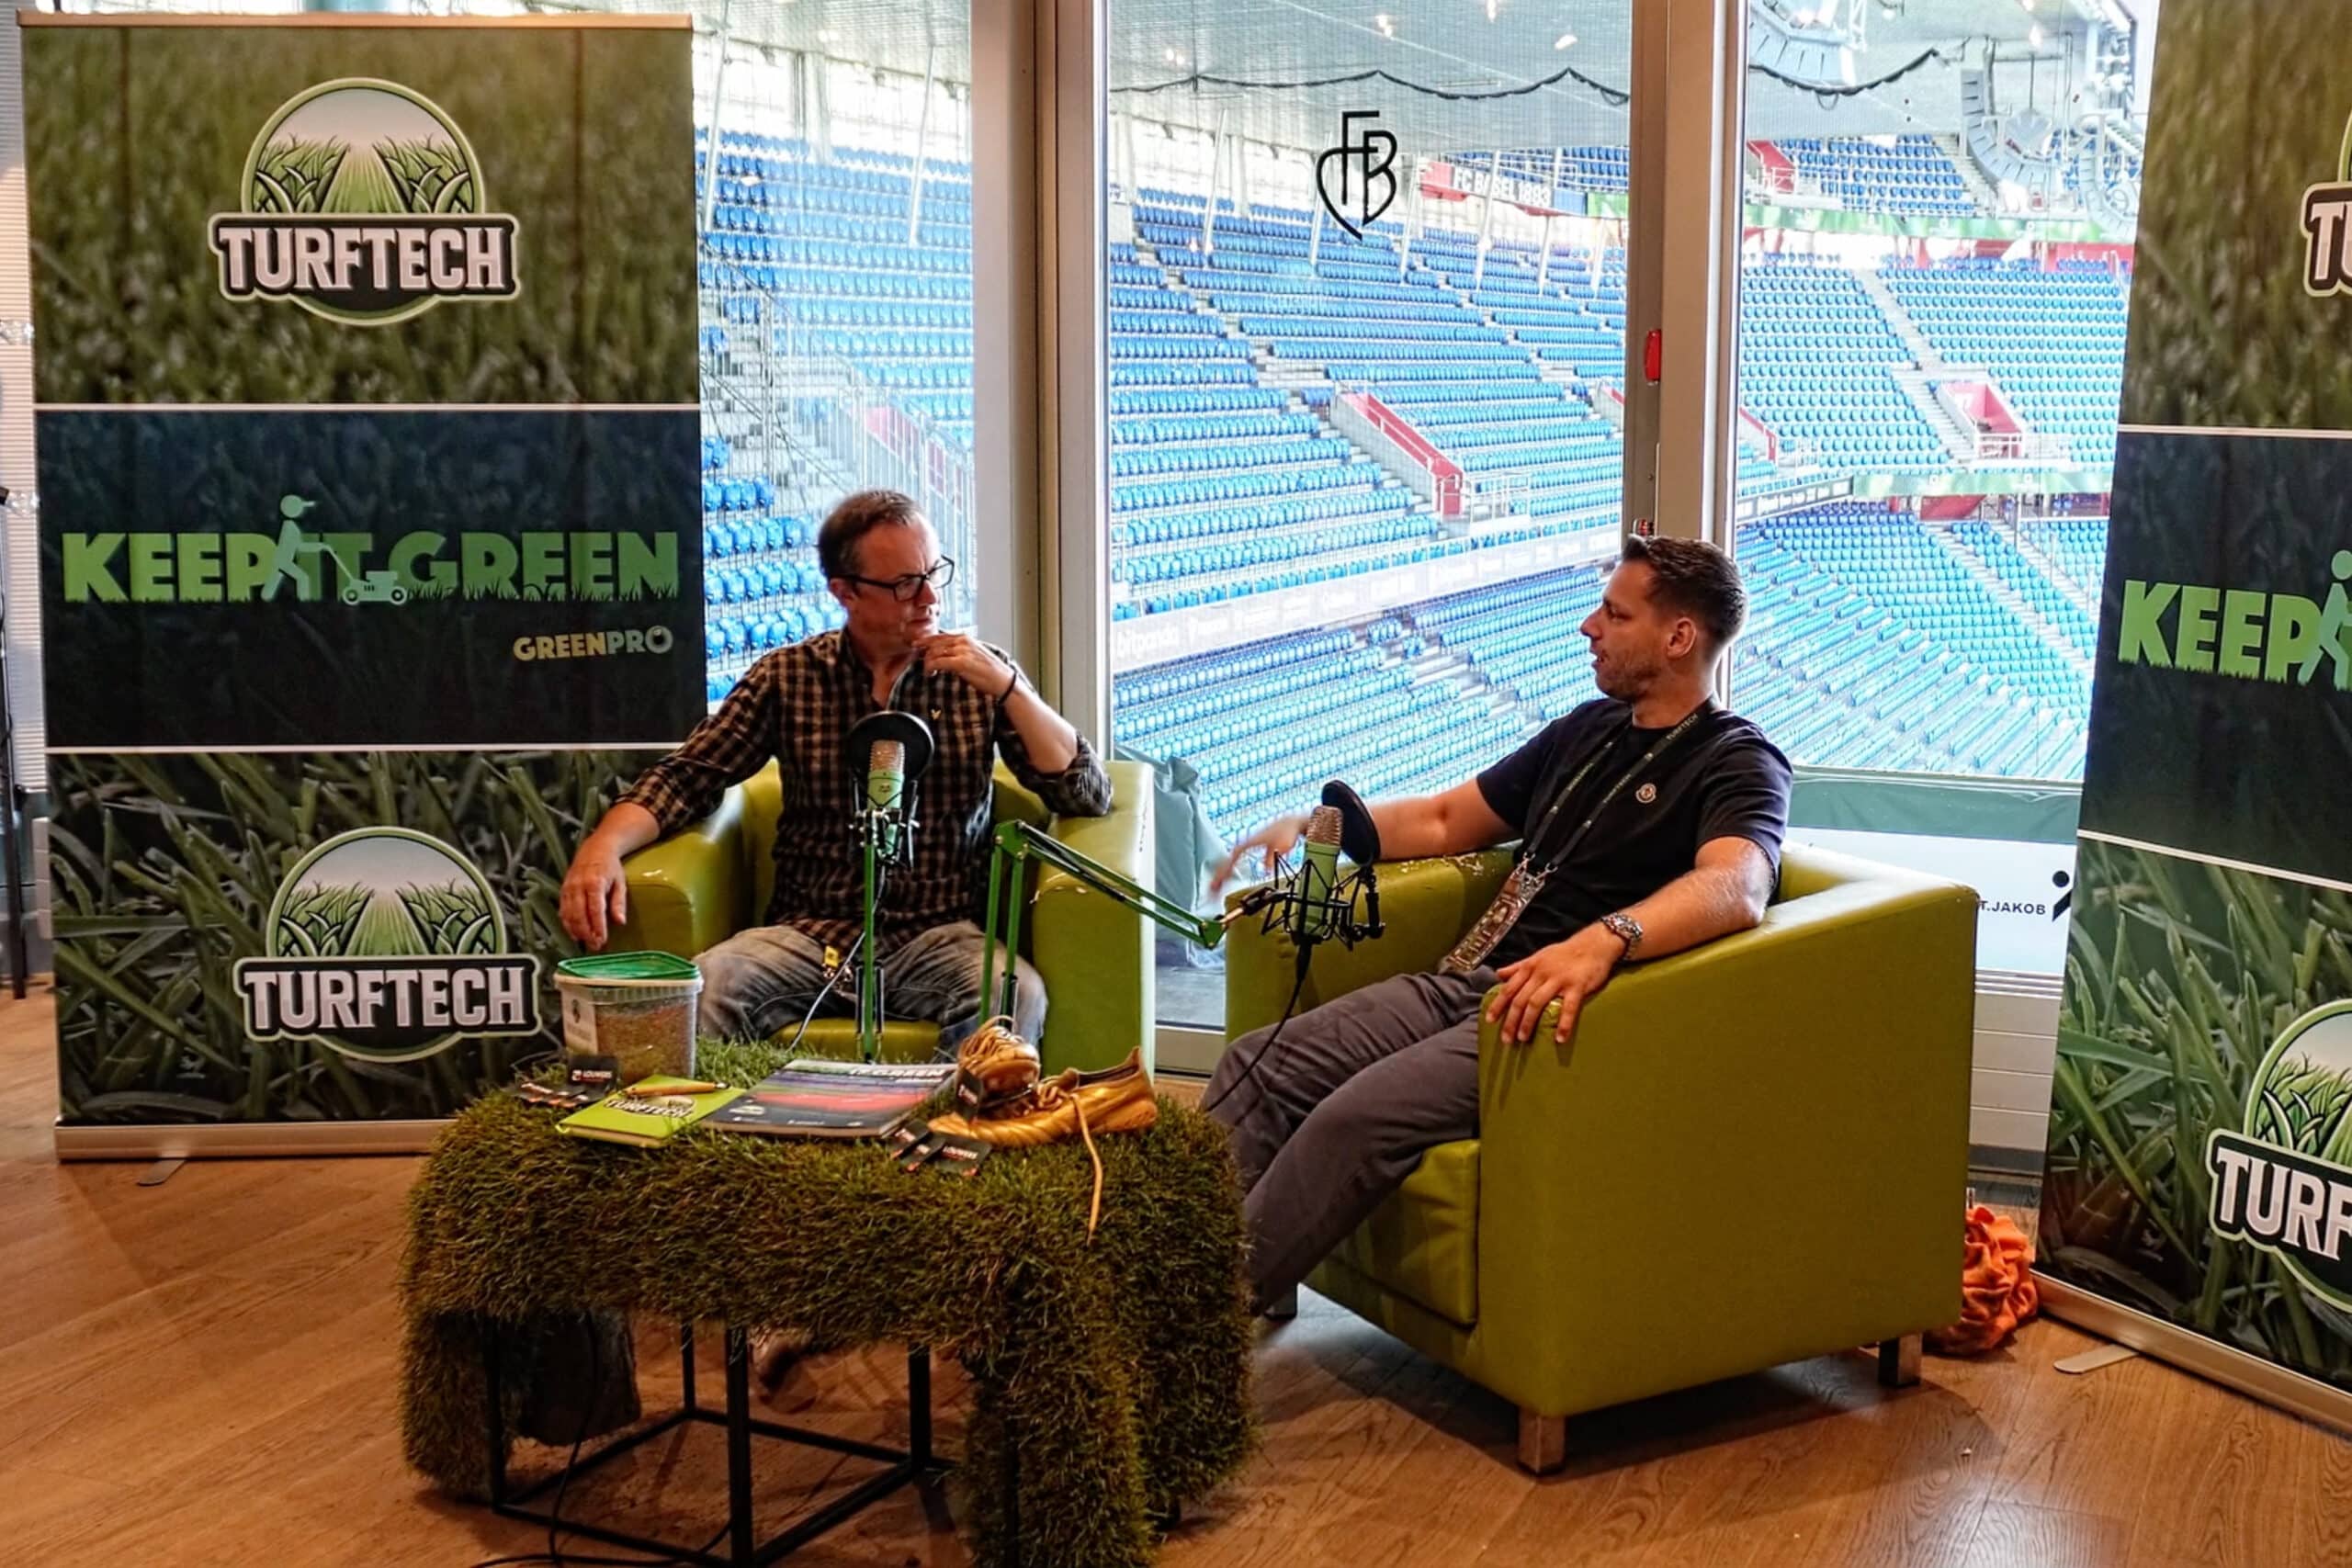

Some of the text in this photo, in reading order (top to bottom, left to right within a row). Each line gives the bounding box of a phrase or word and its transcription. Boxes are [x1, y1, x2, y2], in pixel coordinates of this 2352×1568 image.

[219, 227, 505, 289] TURFTECH
[2310, 201, 2352, 280] T
[62, 532, 279, 602] KEEP
[388, 531, 678, 603] GREEN
[513, 625, 673, 661] GREENPRO
[2118, 579, 2323, 683] KEEP
[243, 966, 526, 1029] TURFTECH
